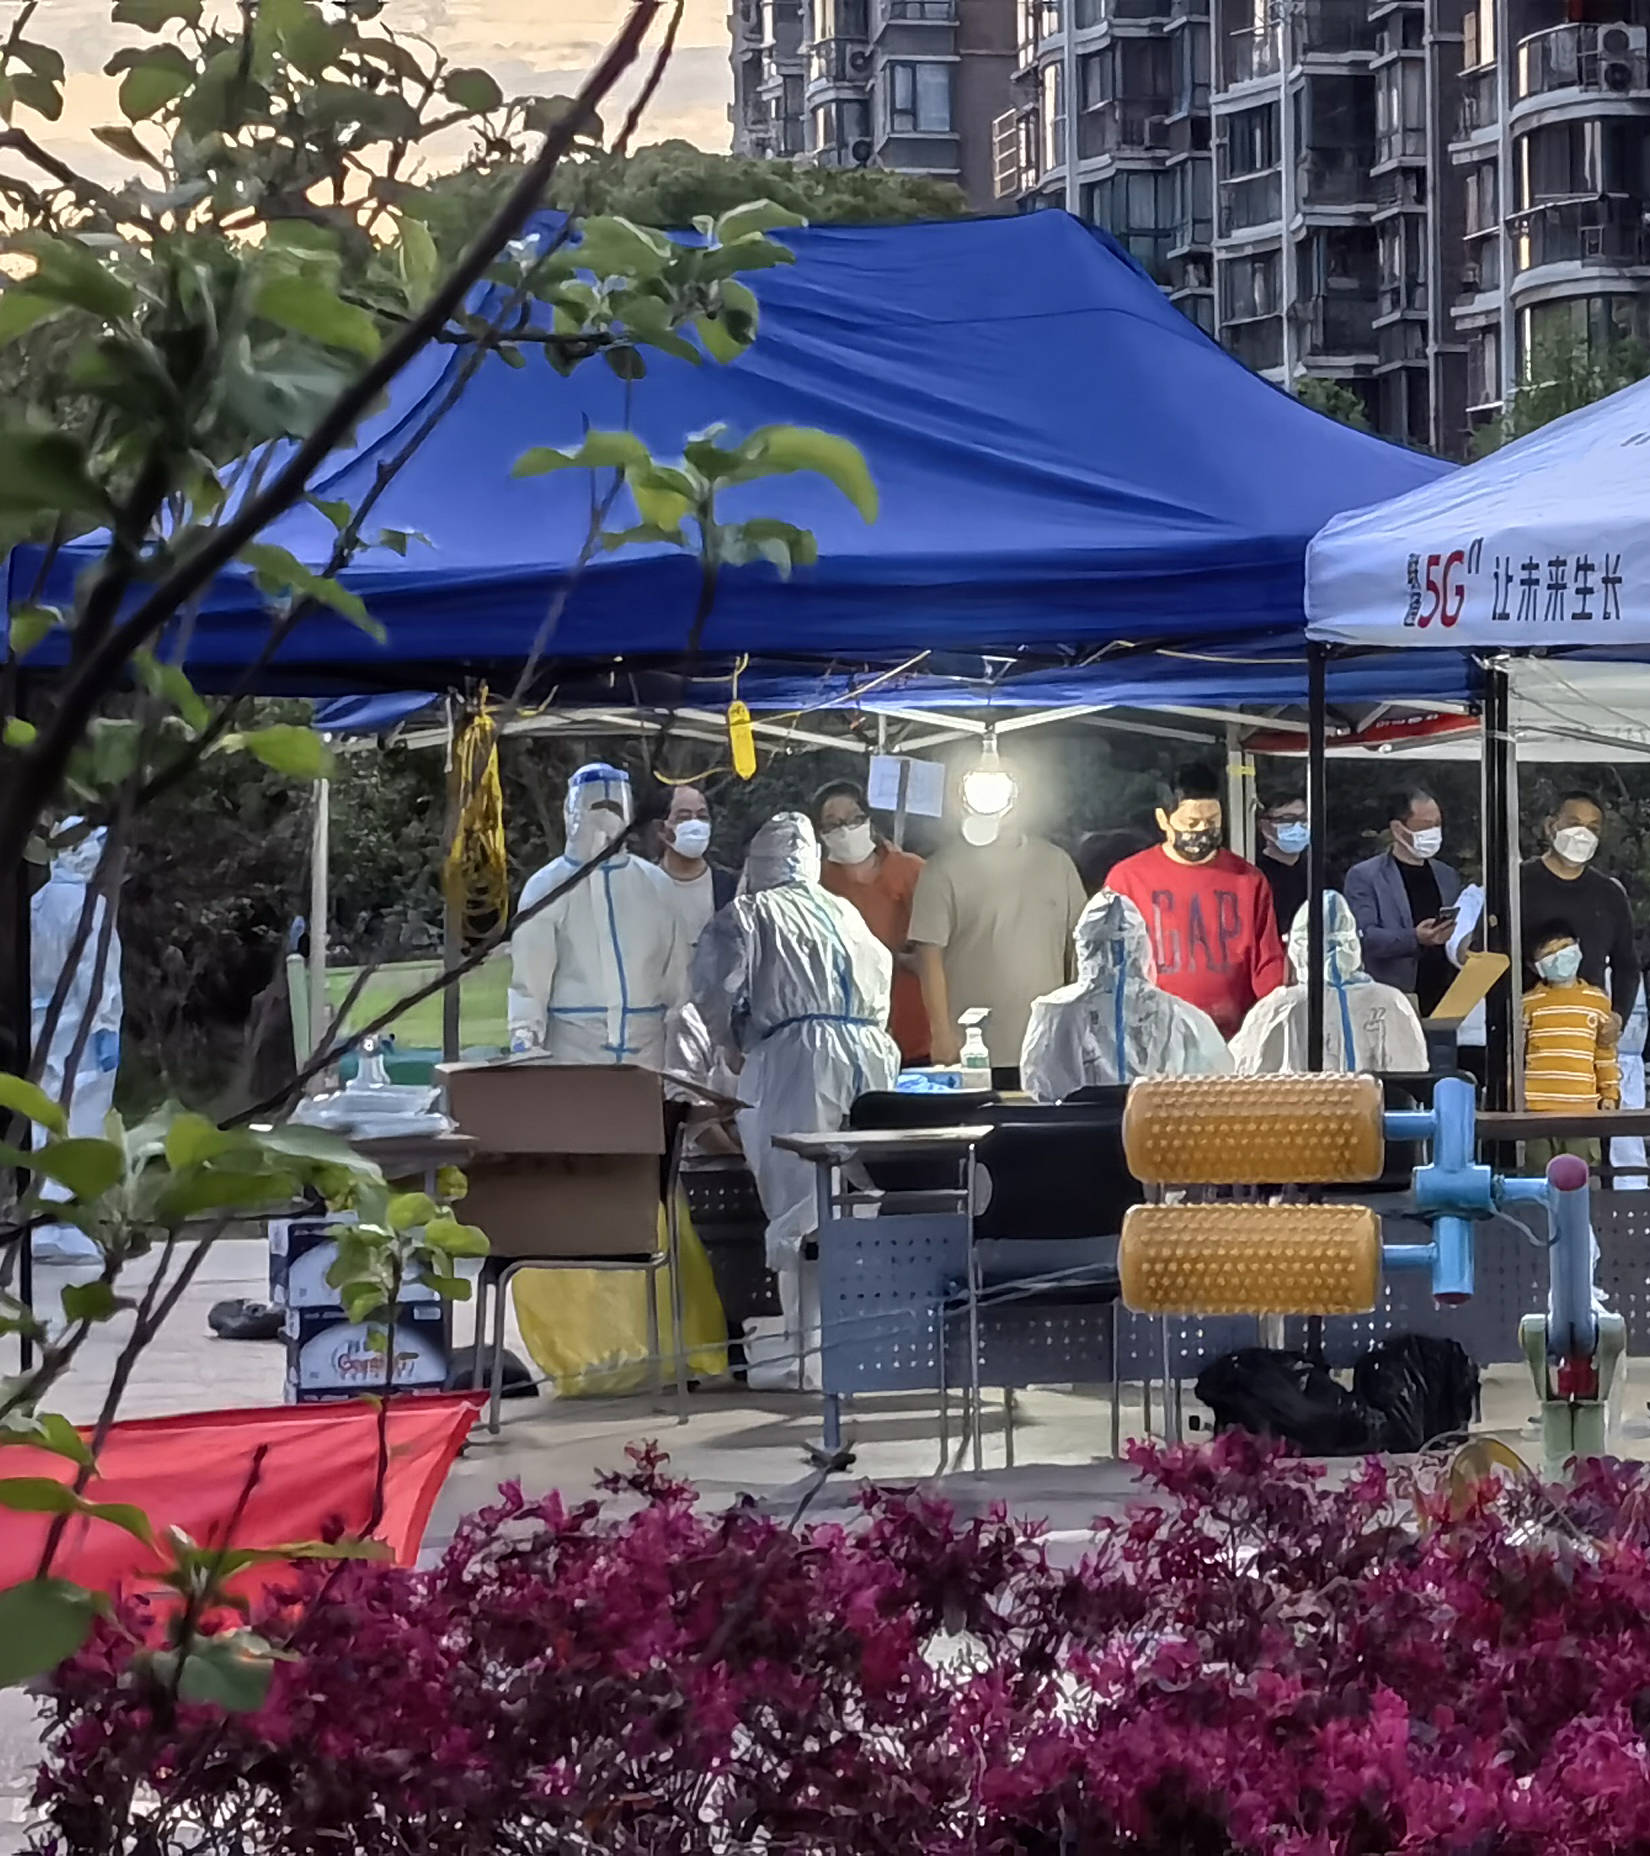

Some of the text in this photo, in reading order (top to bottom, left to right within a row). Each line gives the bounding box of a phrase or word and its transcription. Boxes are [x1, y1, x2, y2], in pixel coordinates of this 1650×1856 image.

[1492, 553, 1623, 621] 让未来生长
[1152, 889, 1242, 975] GAP
